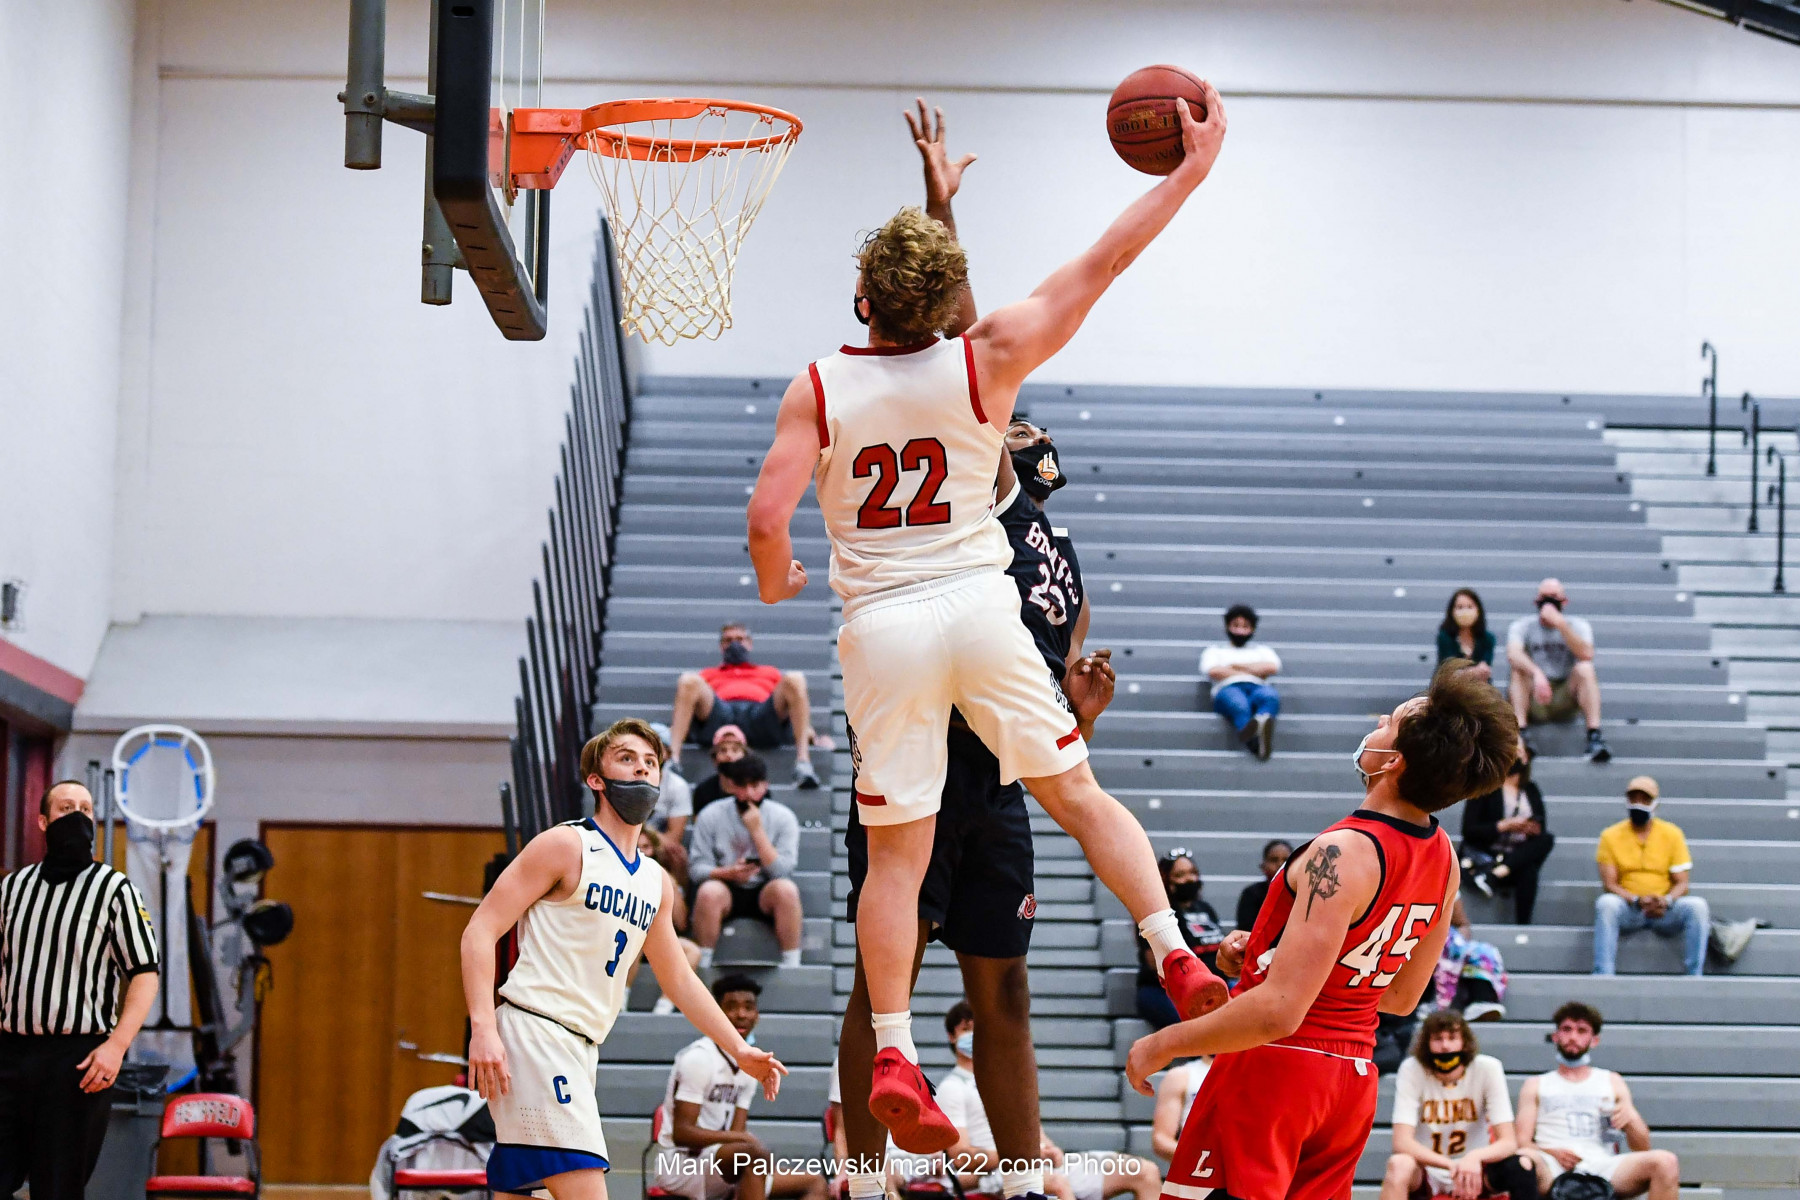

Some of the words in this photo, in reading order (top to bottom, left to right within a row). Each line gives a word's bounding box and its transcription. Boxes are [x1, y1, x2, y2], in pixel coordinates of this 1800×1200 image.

[852, 437, 951, 529] 22
[1337, 903, 1438, 988] 45
[553, 1075, 571, 1104] C
[1431, 1130, 1466, 1155] 12
[1190, 1150, 1214, 1178] L
